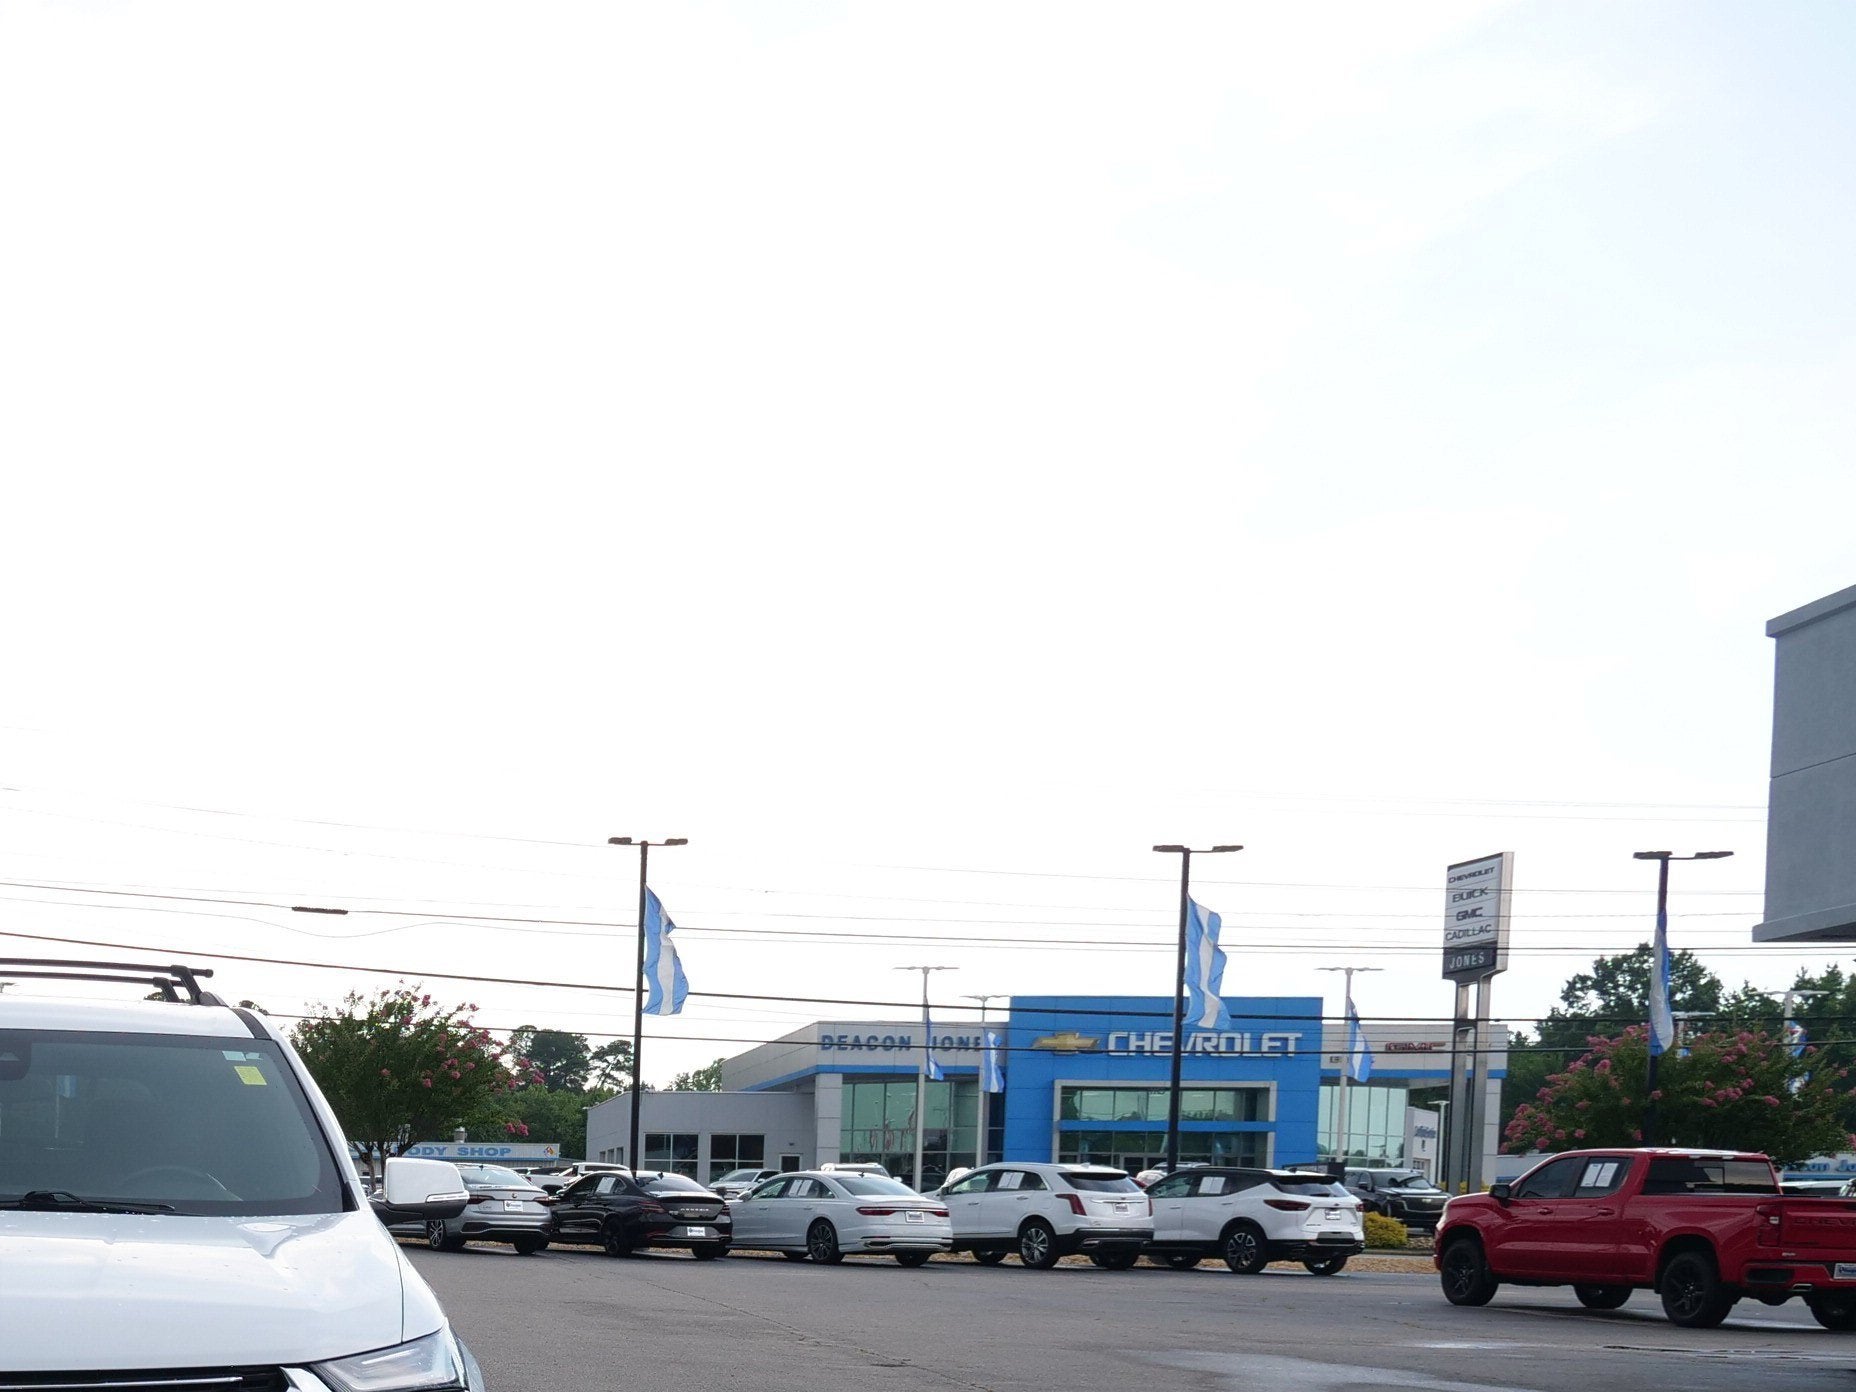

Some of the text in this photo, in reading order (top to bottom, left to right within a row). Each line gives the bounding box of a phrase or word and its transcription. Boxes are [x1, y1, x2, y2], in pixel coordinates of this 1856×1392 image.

[1448, 867, 1495, 883] CHEVROLET
[1452, 886, 1488, 903] BUICK
[1456, 907, 1483, 921] GMC
[1446, 924, 1492, 941] CADILLAC
[1449, 952, 1485, 969] JONES
[821, 1034, 911, 1052] DEACON
[1107, 1032, 1303, 1057] CHEVROLET
[456, 1147, 512, 1157] SHOP
